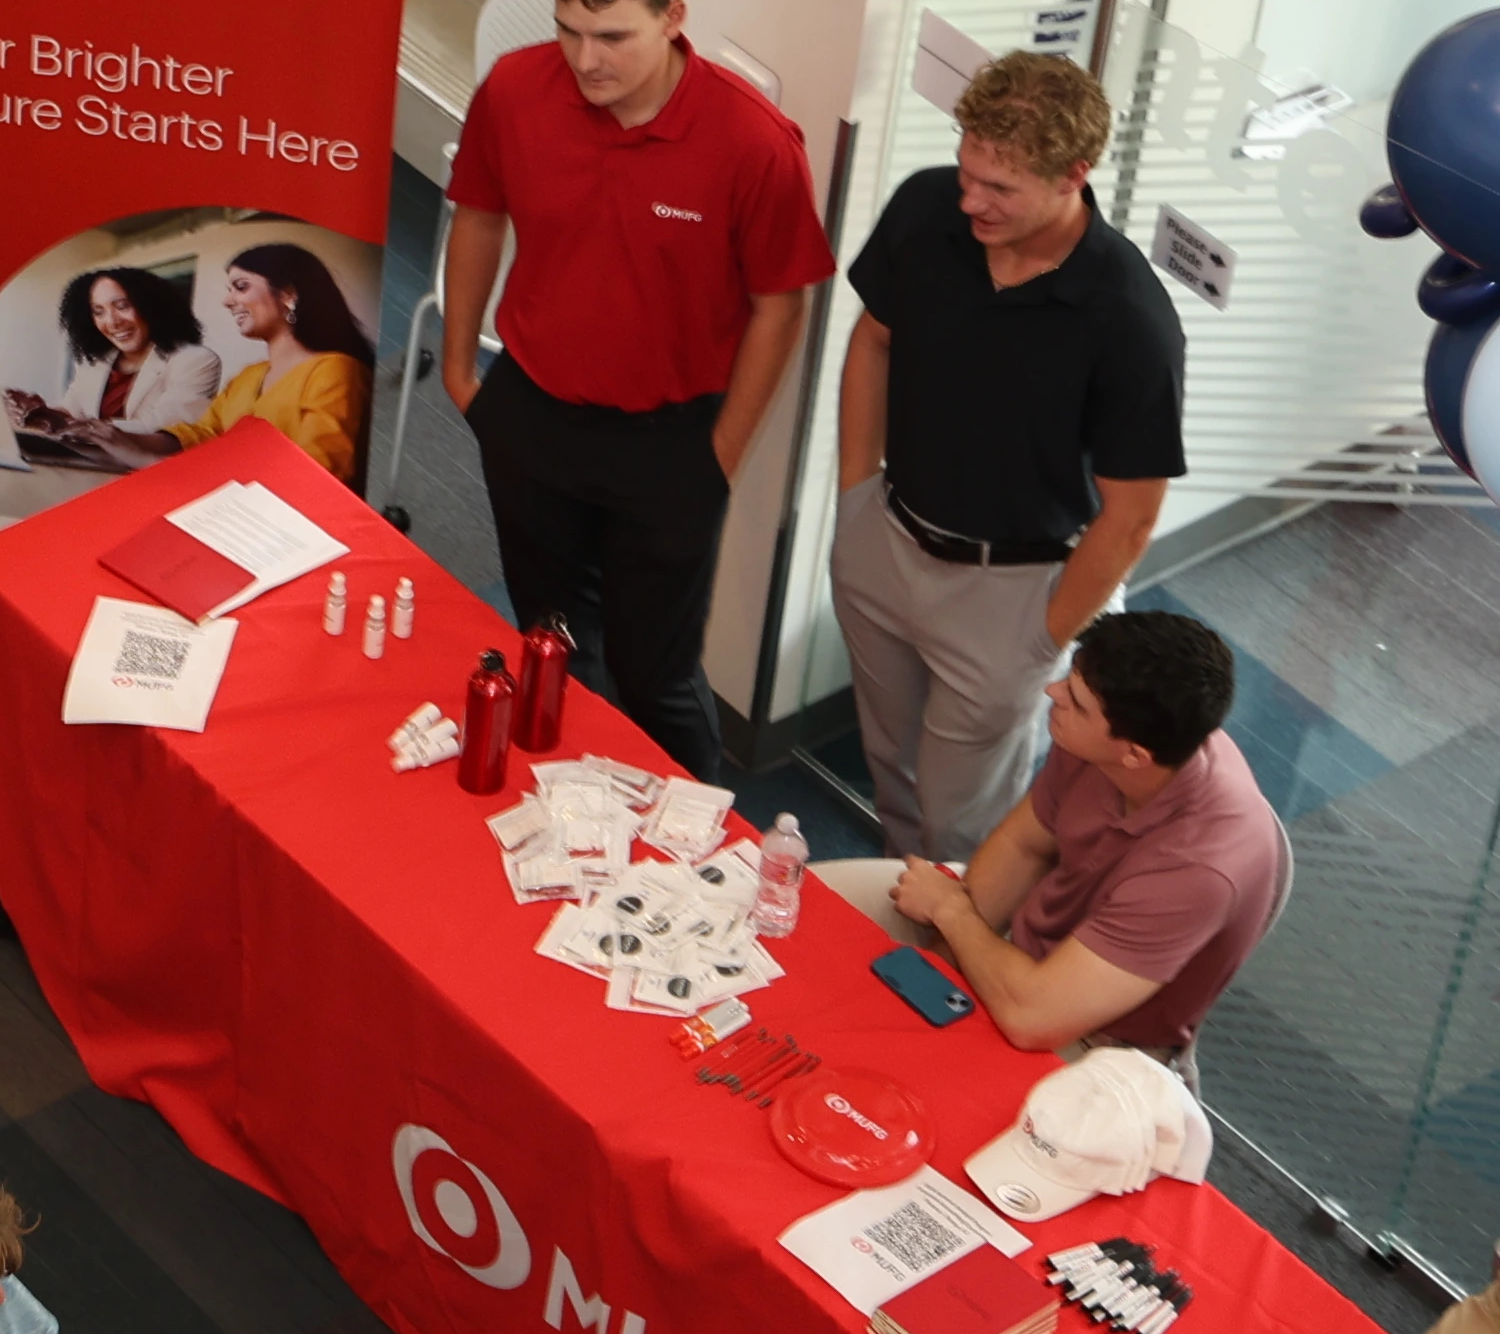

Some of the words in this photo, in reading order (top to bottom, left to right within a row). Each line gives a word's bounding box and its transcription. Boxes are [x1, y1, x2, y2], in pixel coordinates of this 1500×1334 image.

[30, 34, 234, 97] Brighter
[74, 94, 224, 151] Starts
[237, 116, 360, 171] Here
[671, 208, 703, 222] MUFG
[1166, 217, 1209, 255] Please
[1167, 255, 1201, 285] Door
[1171, 240, 1205, 268] Slide
[847, 1107, 889, 1141] MUFG
[1028, 1134, 1058, 1159] MUFG
[870, 1250, 907, 1283] MUFG
